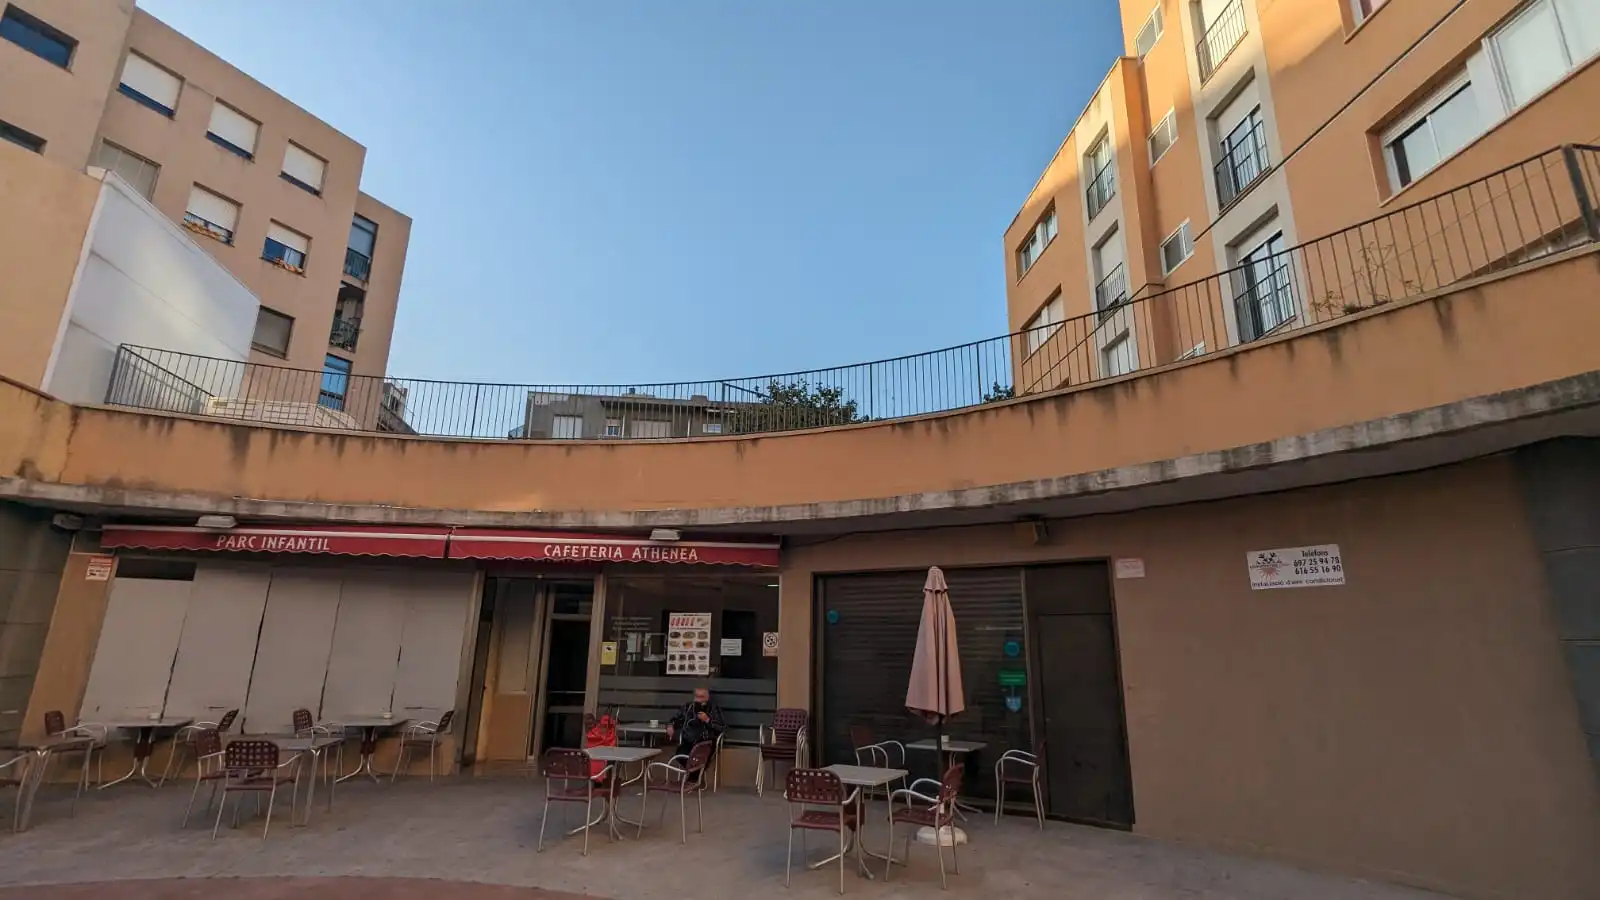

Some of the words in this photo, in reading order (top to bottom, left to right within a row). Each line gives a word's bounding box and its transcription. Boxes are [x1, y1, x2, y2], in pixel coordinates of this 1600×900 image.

[216, 535, 257, 548] PARC
[260, 536, 330, 550] INFANTIL
[544, 544, 623, 558] CAFETERIA
[632, 547, 698, 560] ATHENEA
[1309, 558, 1318, 566] 25
[1309, 566, 1319, 574] 55
[1321, 565, 1330, 573] 16
